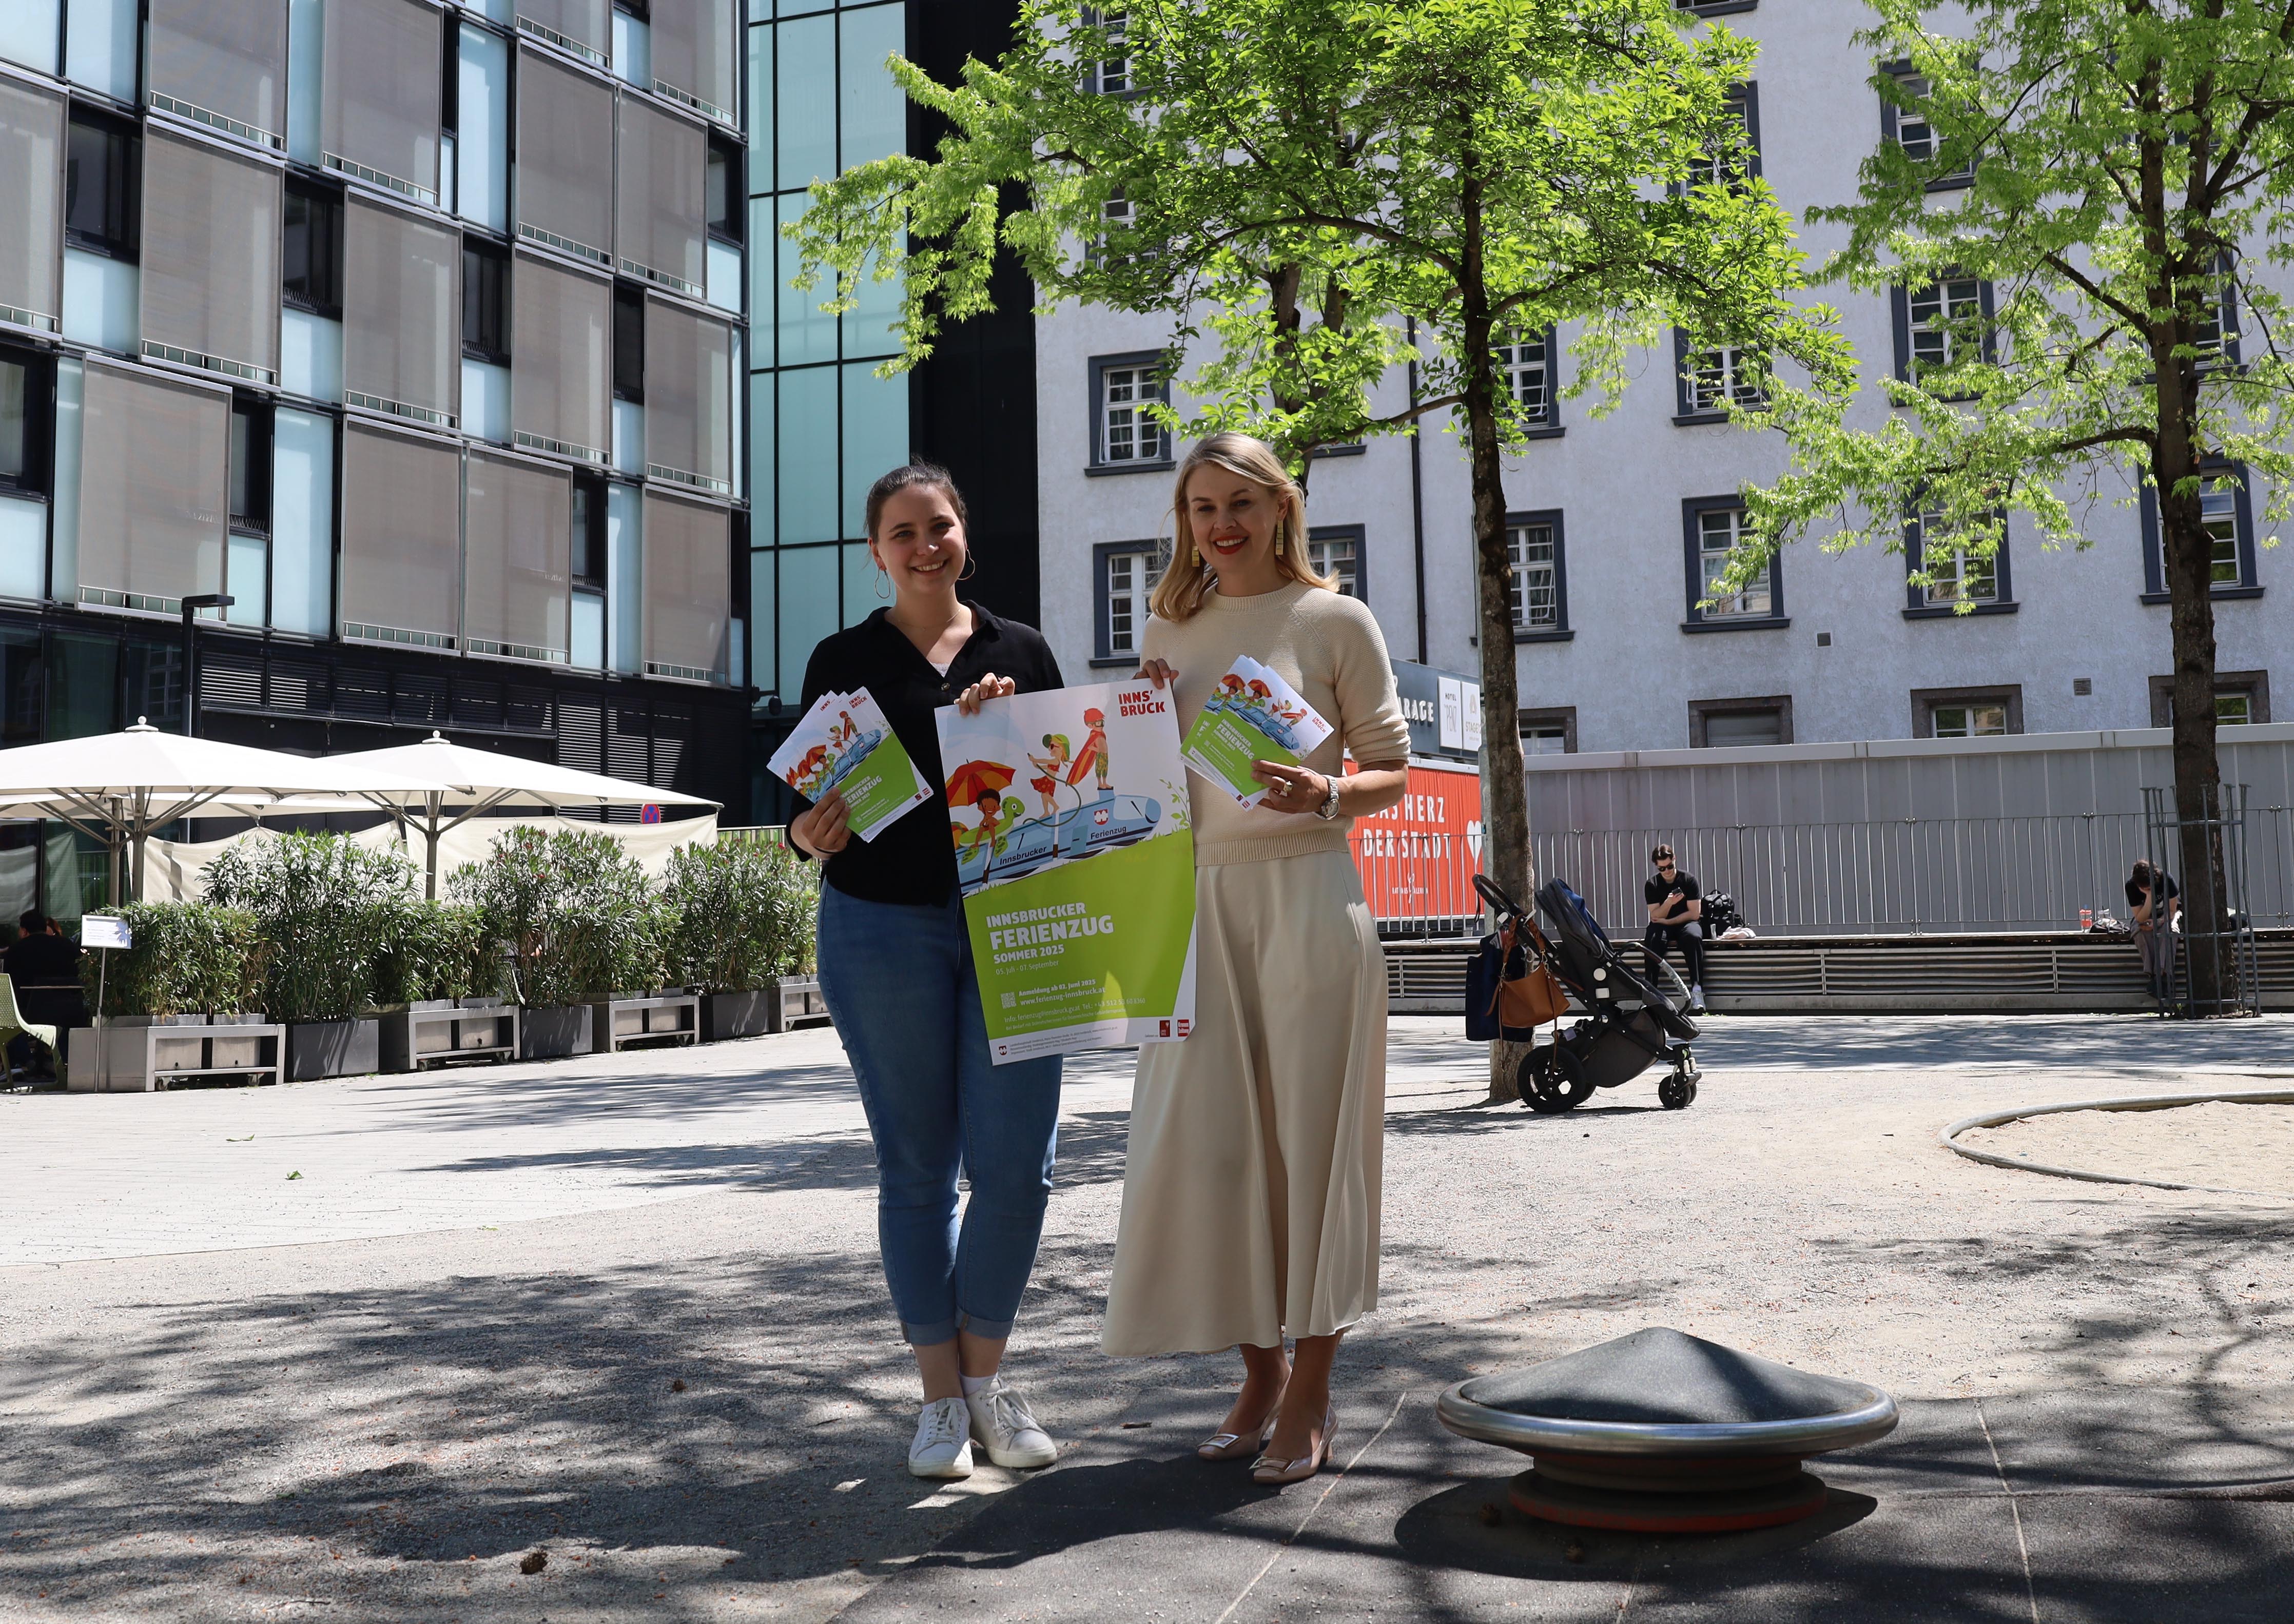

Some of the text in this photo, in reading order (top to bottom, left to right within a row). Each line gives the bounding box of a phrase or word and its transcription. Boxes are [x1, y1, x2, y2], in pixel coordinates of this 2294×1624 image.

[851, 696, 867, 709] BRUCK
[1118, 690, 1153, 705] INNS'
[1445, 693, 1456, 701] HOTEL
[1120, 701, 1165, 717] BRUCK
[1216, 723, 1255, 760] FERIENZUG
[1404, 793, 1445, 823] HERZ
[999, 826, 1127, 865] Innsbrucker Ferienzug
[1363, 828, 1450, 859] DER STADT
[986, 902, 1086, 928] INNSBRUCKER
[989, 915, 1114, 950] FERIENZUG
[994, 944, 1064, 964] SOMMER 2025
[1006, 966, 1015, 975] Juli
[1029, 960, 1059, 971] September
[1019, 988, 1050, 996] Anmeldung
[1068, 981, 1080, 990] Juni
[1020, 987, 1105, 1006] www.ferienzug-innsbruck.at
